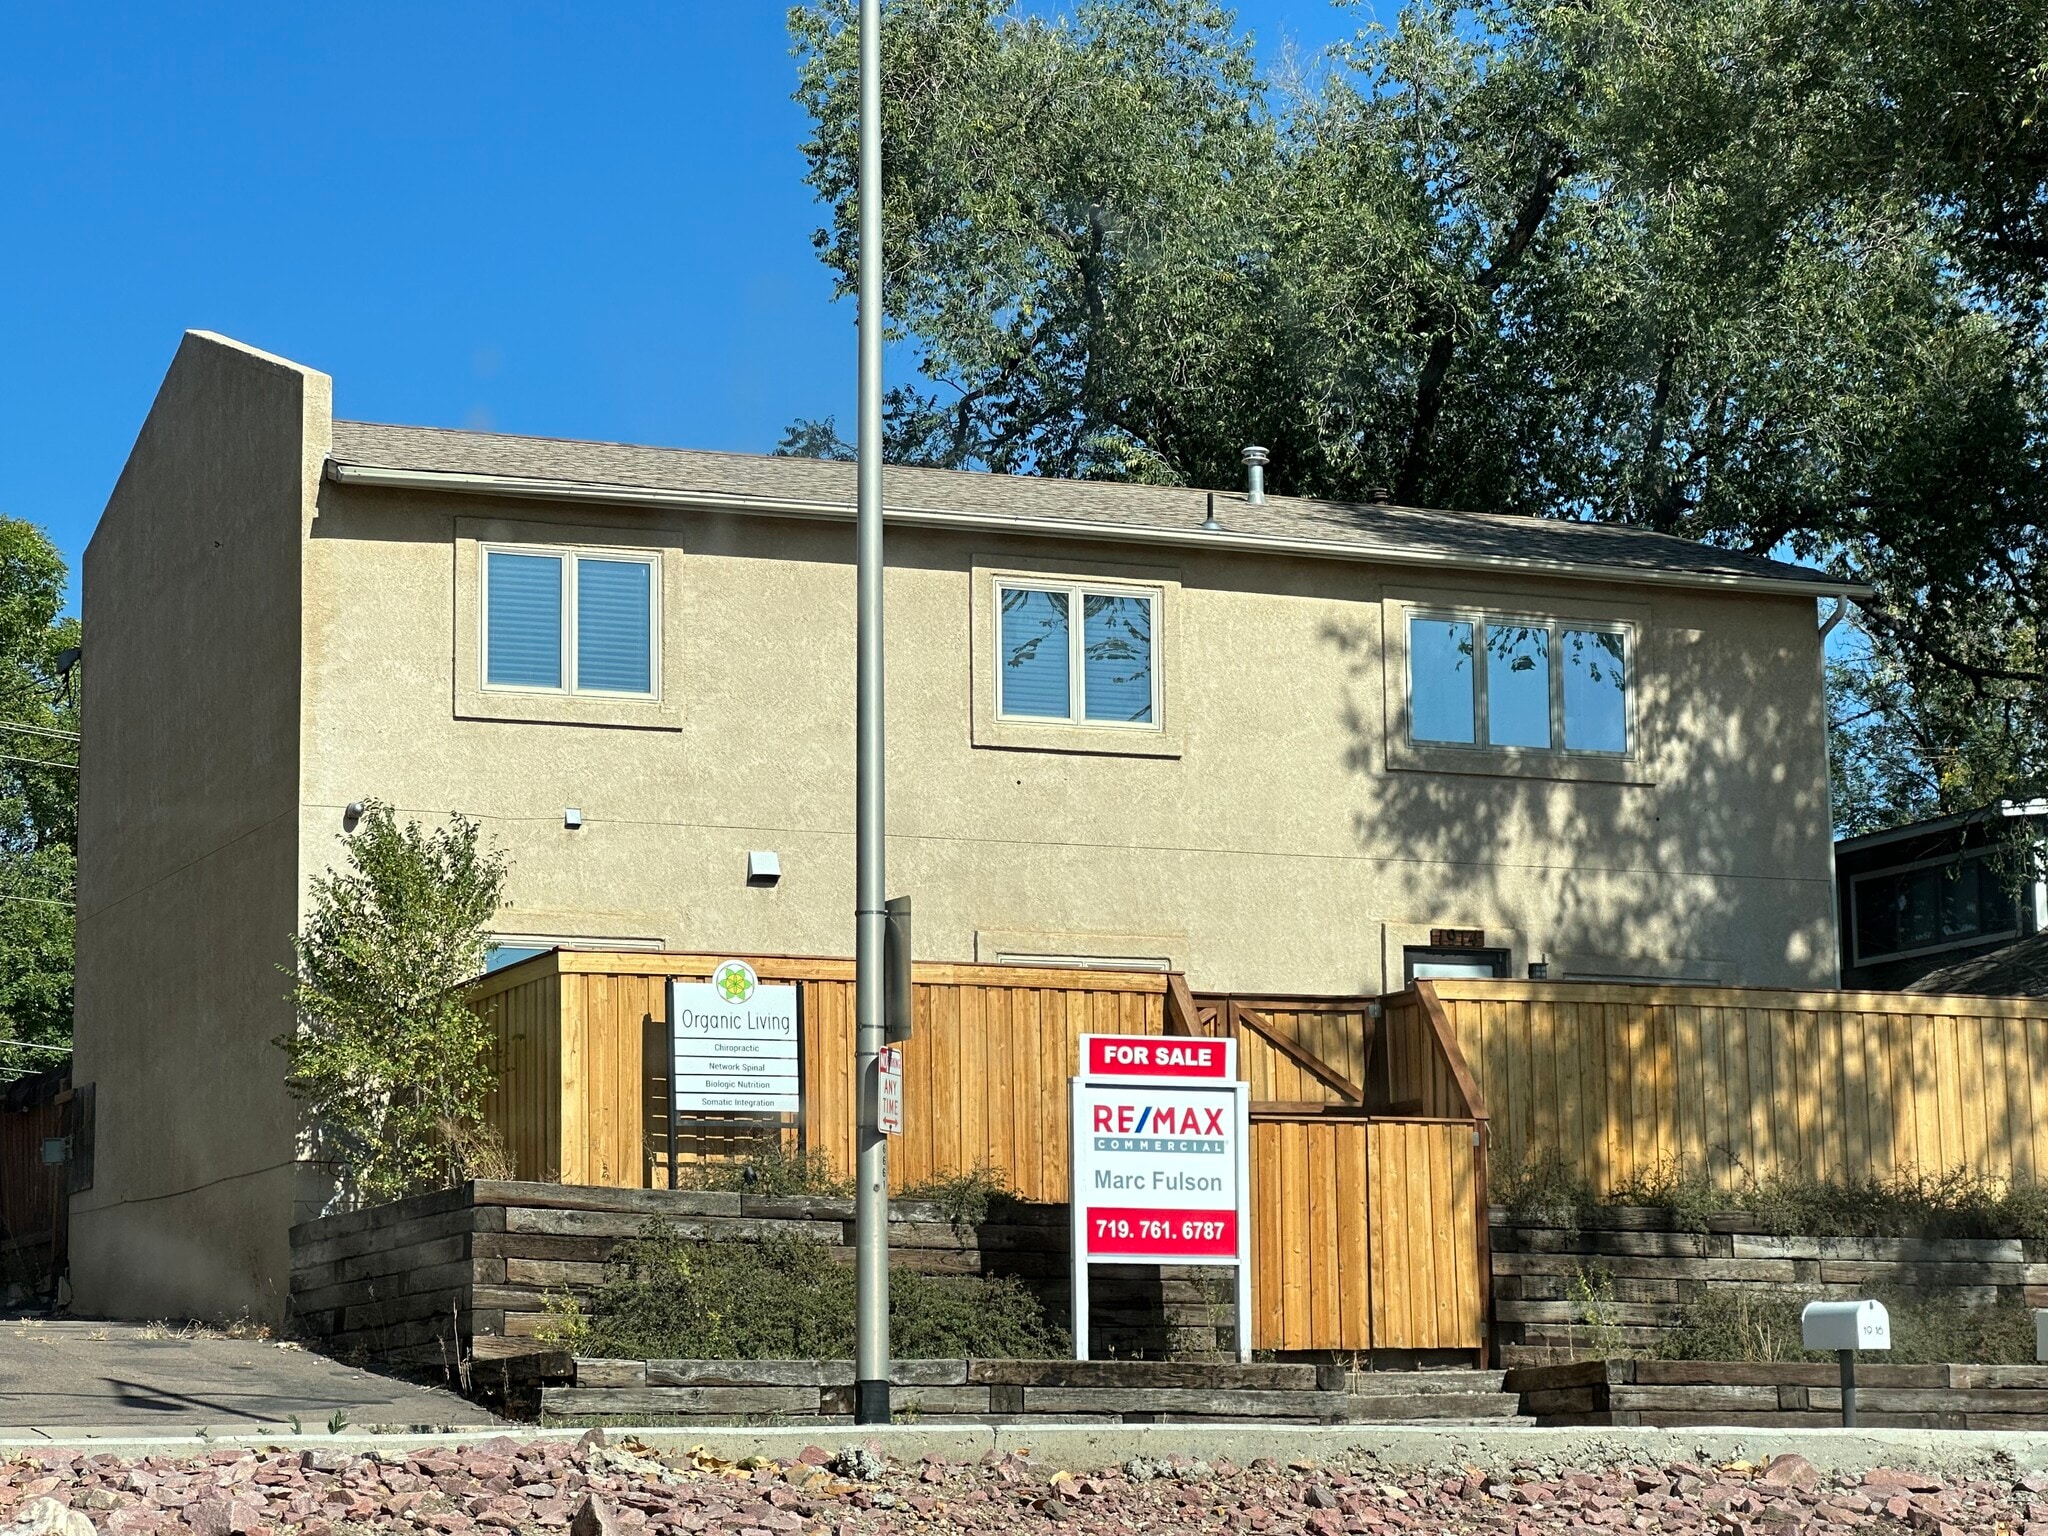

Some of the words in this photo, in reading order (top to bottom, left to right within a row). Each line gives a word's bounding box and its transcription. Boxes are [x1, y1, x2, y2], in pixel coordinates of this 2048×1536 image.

[682, 1009, 741, 1034] Organic
[748, 1011, 790, 1035] Living
[714, 1043, 760, 1053] Chiropractic
[1104, 1046, 1149, 1065] FOR
[1155, 1048, 1212, 1067] SALE
[709, 1062, 740, 1071] Network
[742, 1063, 765, 1073] Spinal
[705, 1079, 736, 1090] Biologic
[738, 1080, 770, 1089] Nutrition
[884, 1079, 897, 1096] ANY
[702, 1097, 733, 1106] Somatic
[734, 1098, 775, 1109] Integration
[883, 1097, 898, 1116] TIME
[1094, 1104, 1224, 1136] RE/MAX
[1097, 1139, 1222, 1152] COMMERCIAL
[1095, 1169, 1145, 1190] Marc
[1153, 1171, 1222, 1191] Fulson
[1096, 1220, 1134, 1239] 719.
[1139, 1221, 1177, 1240] 761.
[1182, 1221, 1225, 1240] 6787
